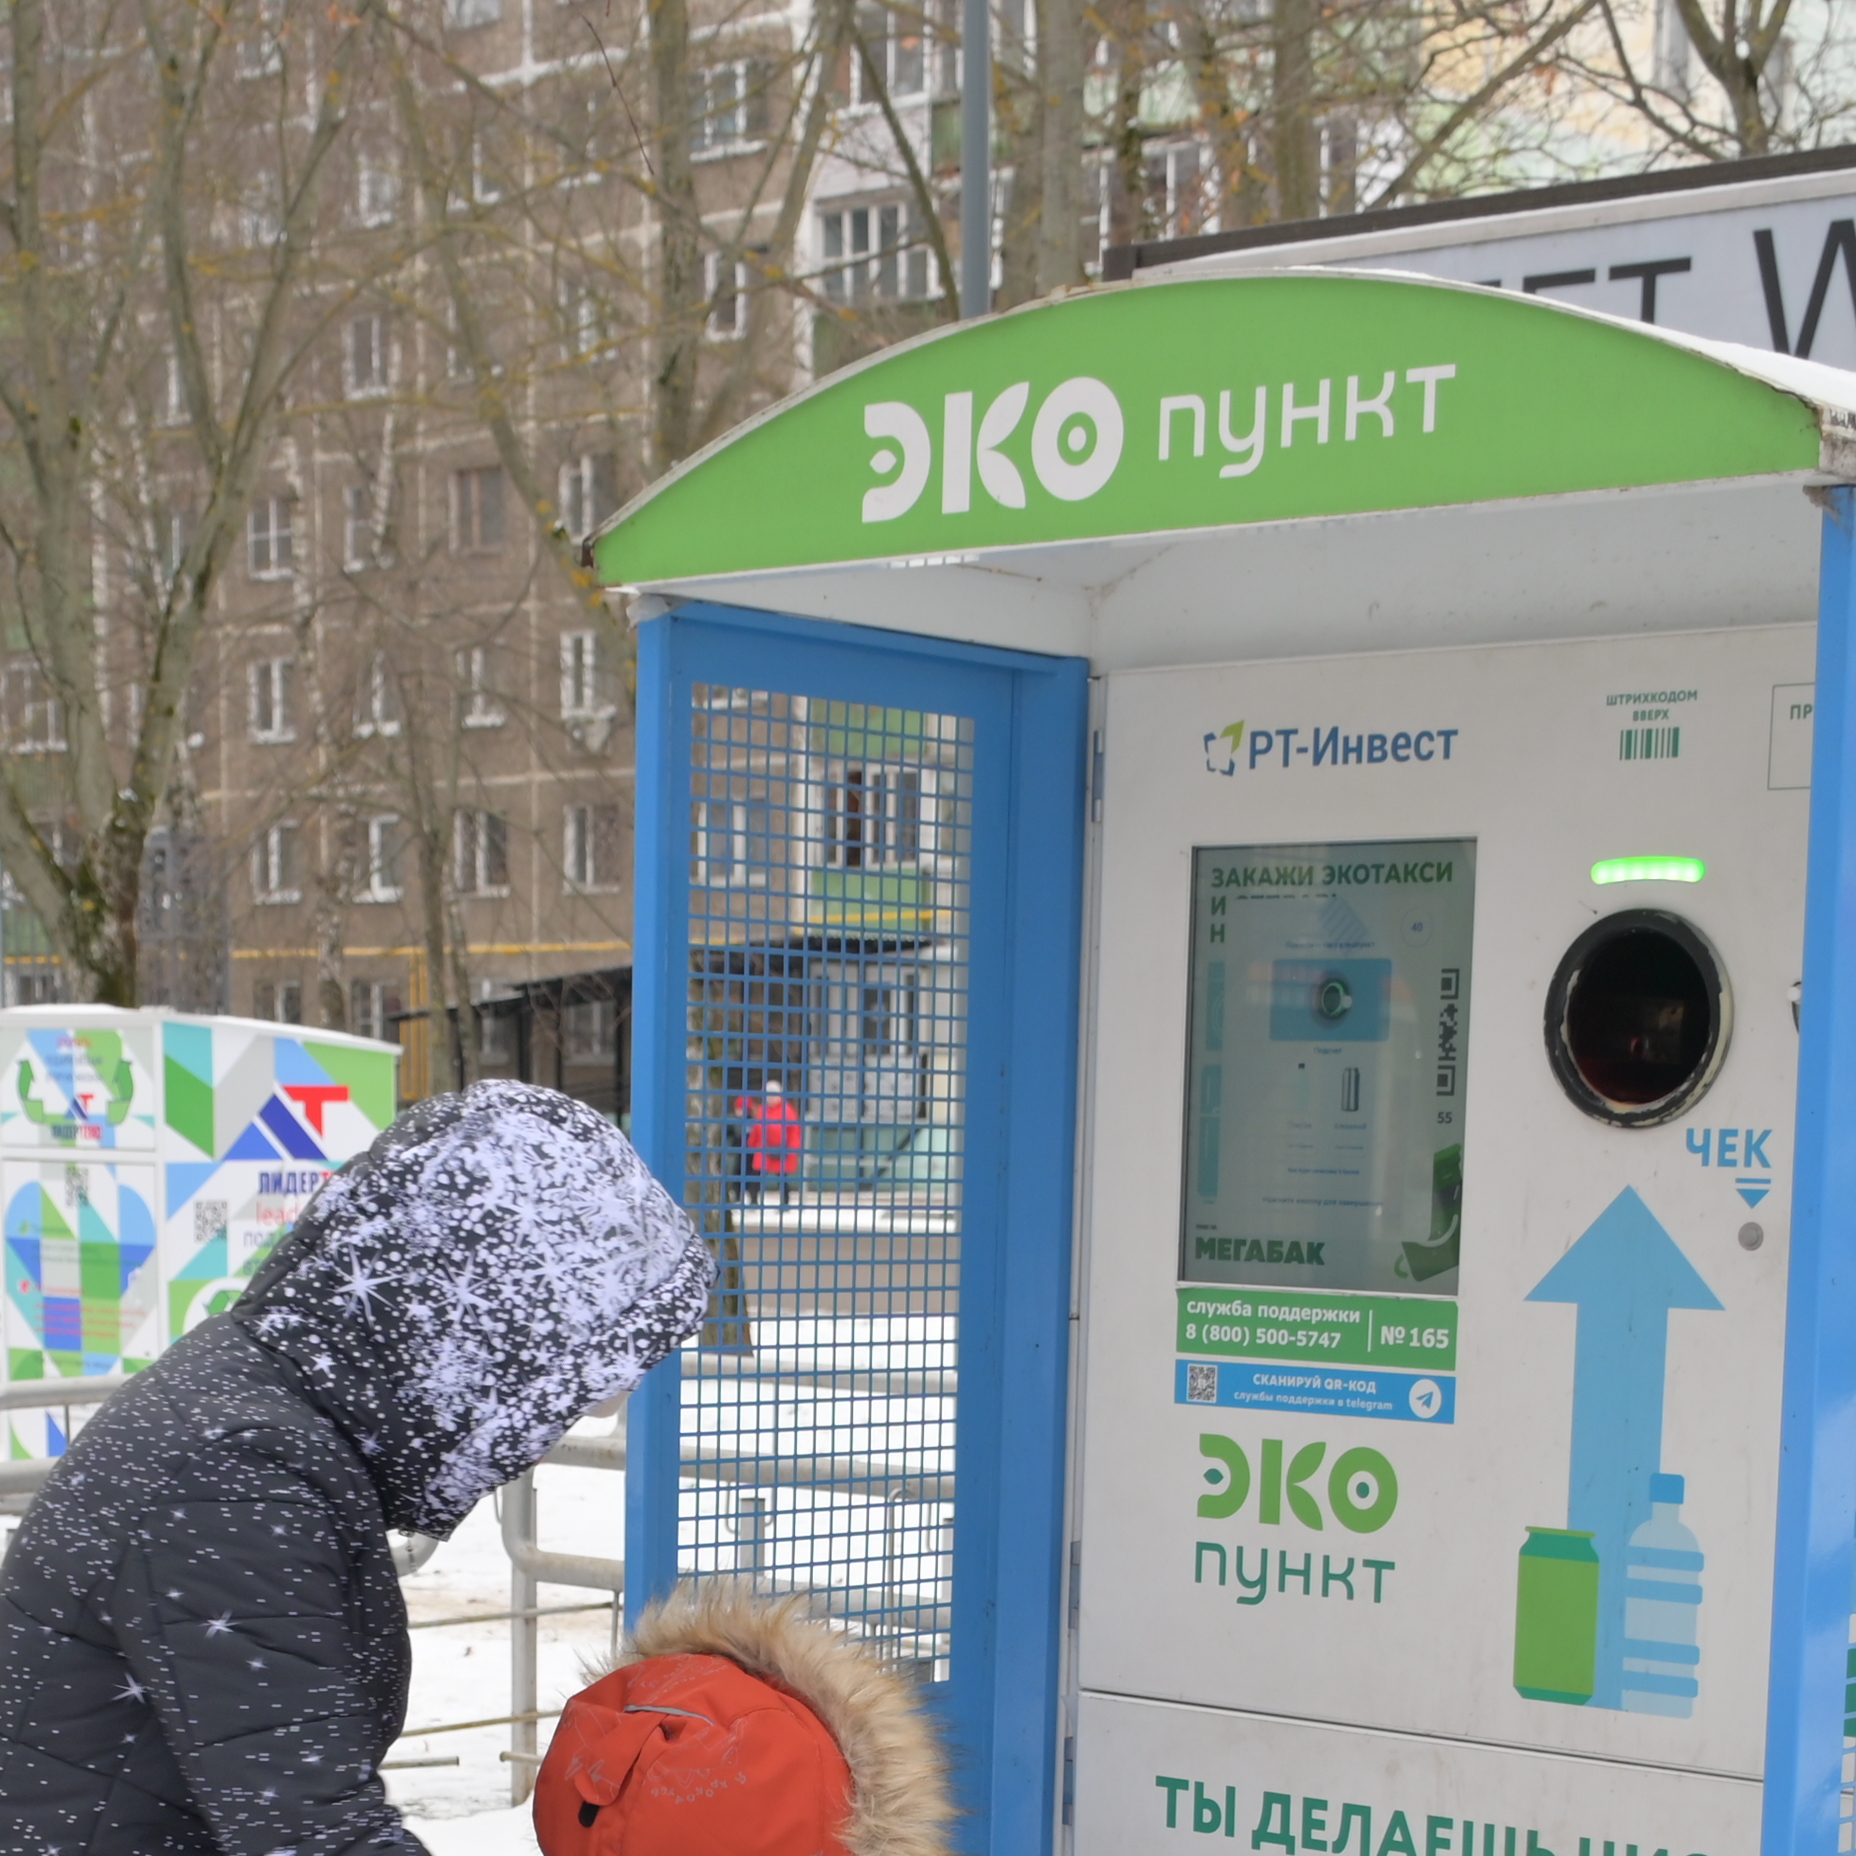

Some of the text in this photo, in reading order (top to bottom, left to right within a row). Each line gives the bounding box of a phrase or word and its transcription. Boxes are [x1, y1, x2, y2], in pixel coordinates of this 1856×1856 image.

[862, 376, 1124, 523] ЭКО
[1606, 690, 1698, 706] ШТРИХКОДОМ
[1633, 708, 1670, 722] ВВЕРХ
[1247, 726, 1459, 771] РТ-Инвест
[1211, 861, 1453, 888] ЗАКАЖИ ЭКОТАКСИ
[1684, 1128, 1773, 1169] ЧЕК
[1195, 1236, 1325, 1266] МЕГАБАК
[1186, 1300, 1360, 1325] служба поддержки
[1185, 1323, 1341, 1349] 8 (800) 500-5747
[1253, 1372, 1377, 1395] СКАНИРУЙ QR-КОД
[1234, 1390, 1274, 1403] службы
[1275, 1393, 1335, 1408] поддержки
[1346, 1397, 1393, 1412] telegram
[1196, 1432, 1399, 1535] ЭКО
[1154, 1775, 1236, 1837] ТЫ
